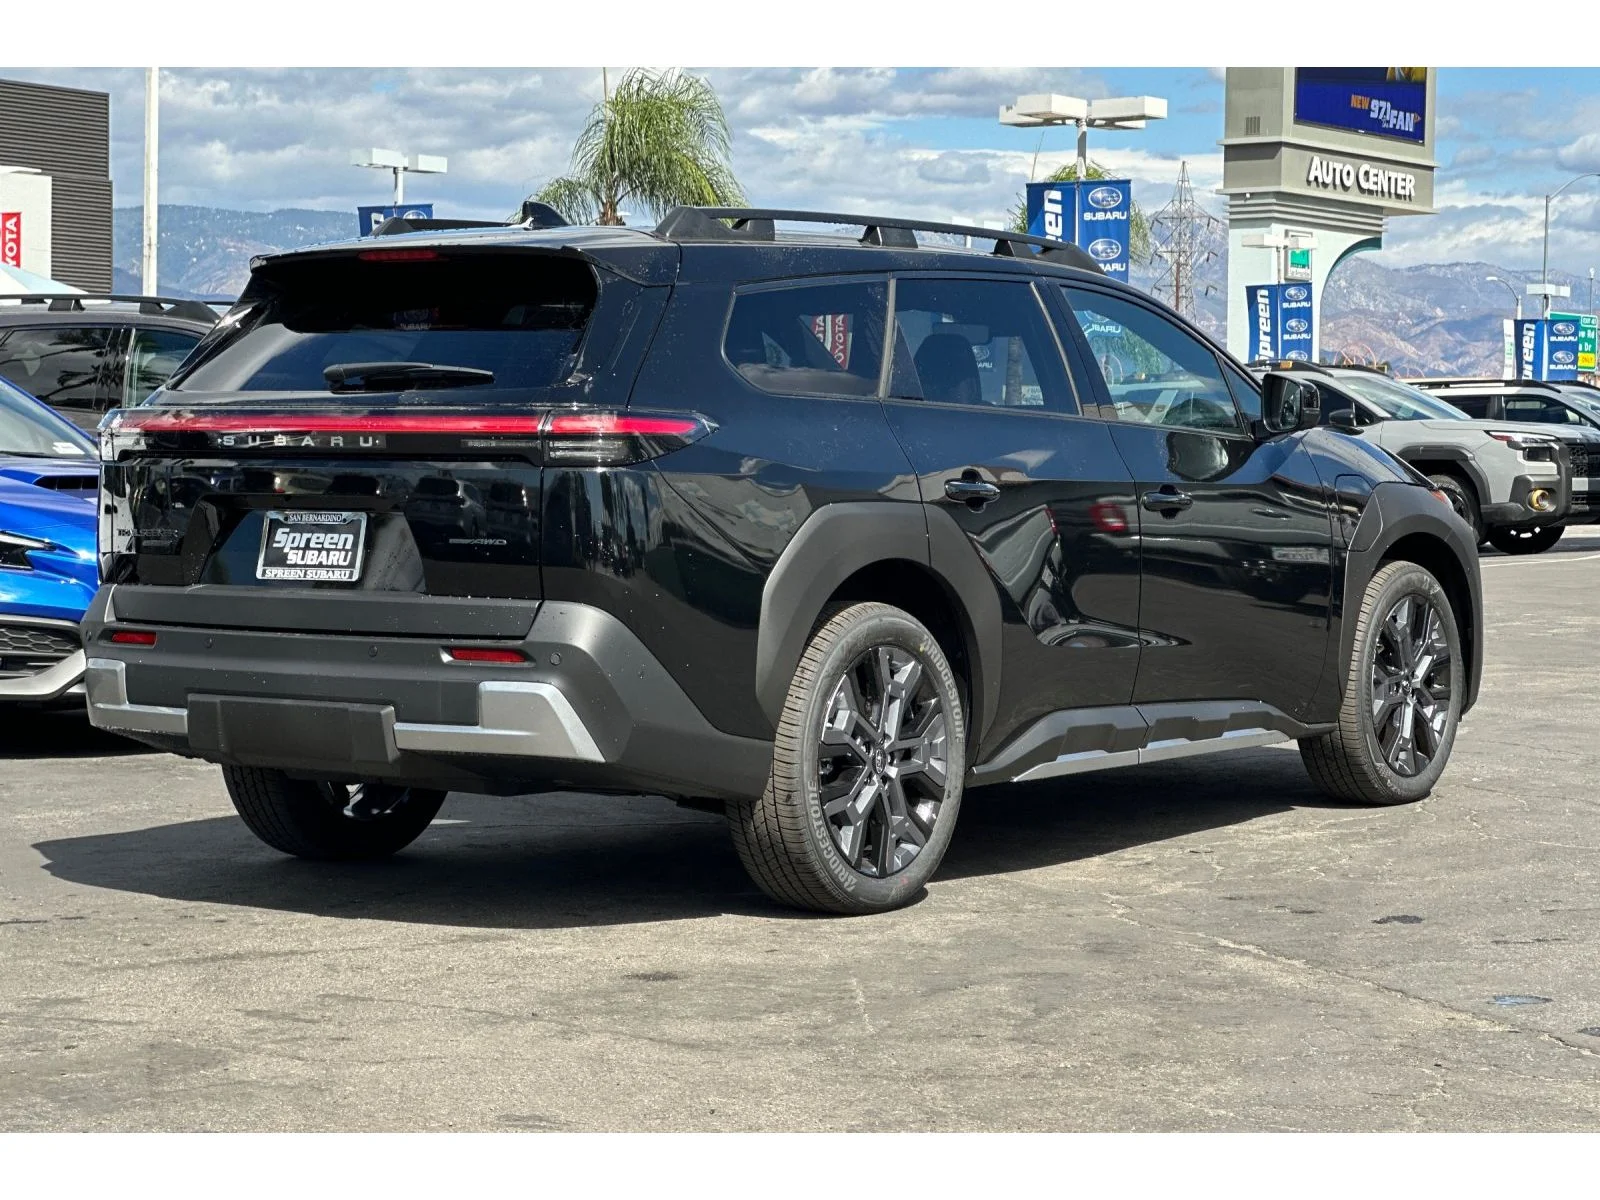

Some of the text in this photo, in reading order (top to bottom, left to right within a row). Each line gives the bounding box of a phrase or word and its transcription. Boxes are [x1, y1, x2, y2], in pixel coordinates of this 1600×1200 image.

[1351, 94, 1370, 110] NEW
[1389, 109, 1415, 132] FAN
[1308, 156, 1416, 197] AUTO CENTER
[1083, 211, 1127, 221] SUBARU
[222, 435, 373, 447] SUBARU
[289, 513, 344, 522] SAN BERNARDINO
[272, 527, 354, 553] Spreen
[286, 549, 352, 566] SUBARU
[264, 568, 351, 579] SPREEN SUBARU
[921, 633, 965, 743] BRIDGESTONE
[807, 780, 858, 893] BRIDGESTONE
